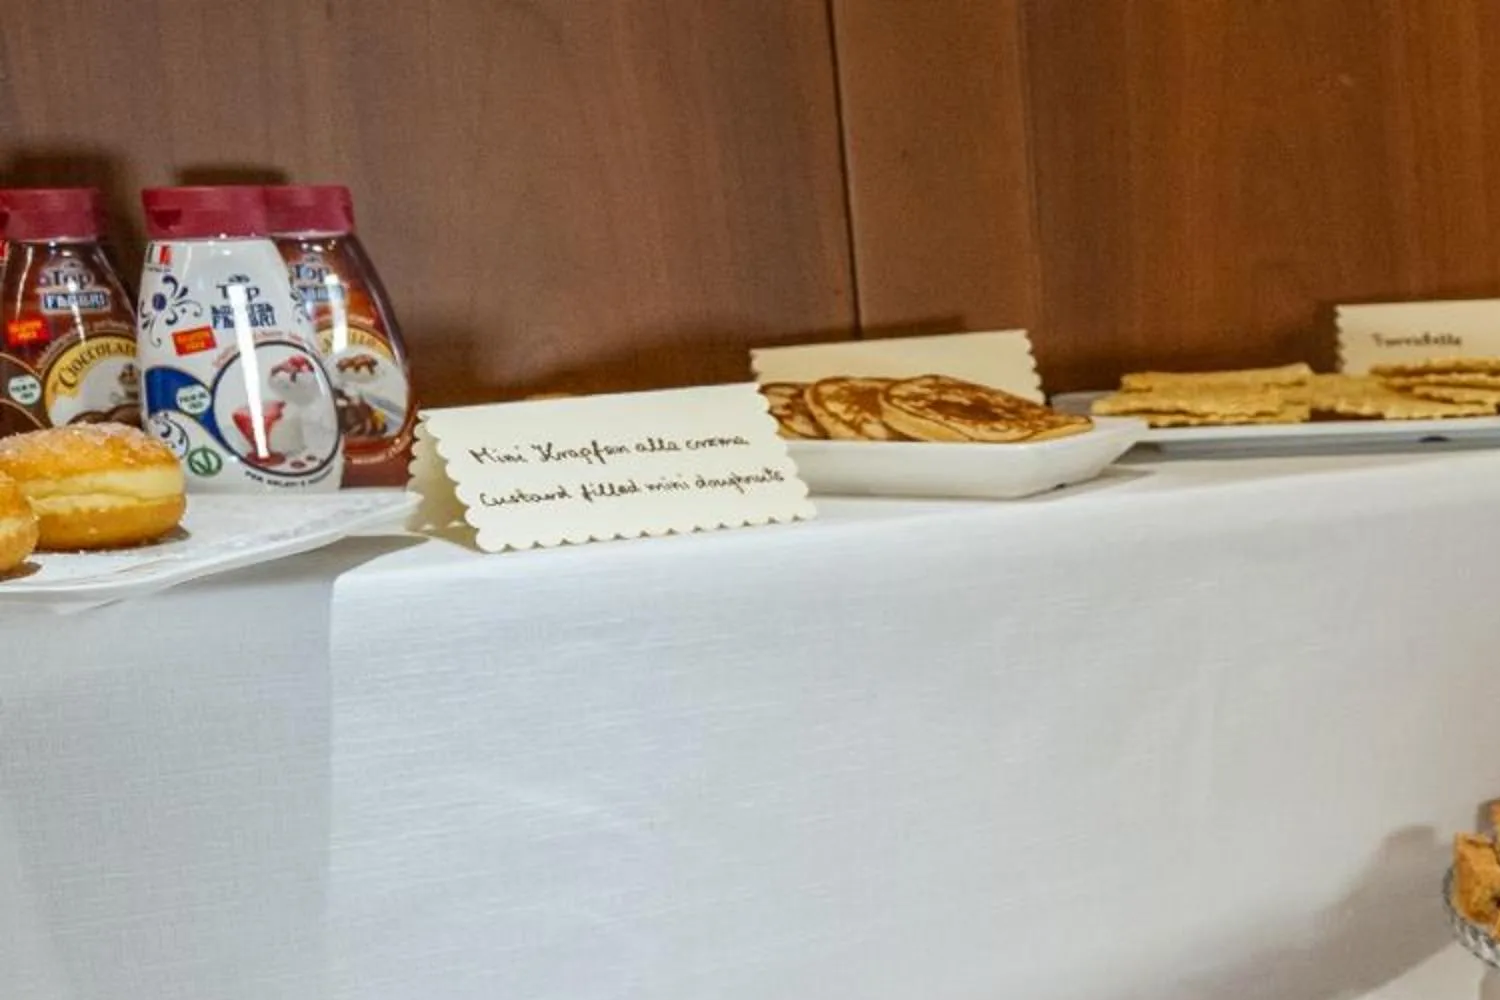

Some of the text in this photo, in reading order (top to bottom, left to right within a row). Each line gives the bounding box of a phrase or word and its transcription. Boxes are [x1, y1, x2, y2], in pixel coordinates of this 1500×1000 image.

[216, 284, 260, 300] Tp
[468, 445, 527, 465] Mini
[634, 436, 681, 453] alla
[685, 434, 751, 452] crema
[478, 485, 572, 508] Custard
[580, 479, 641, 503] filled
